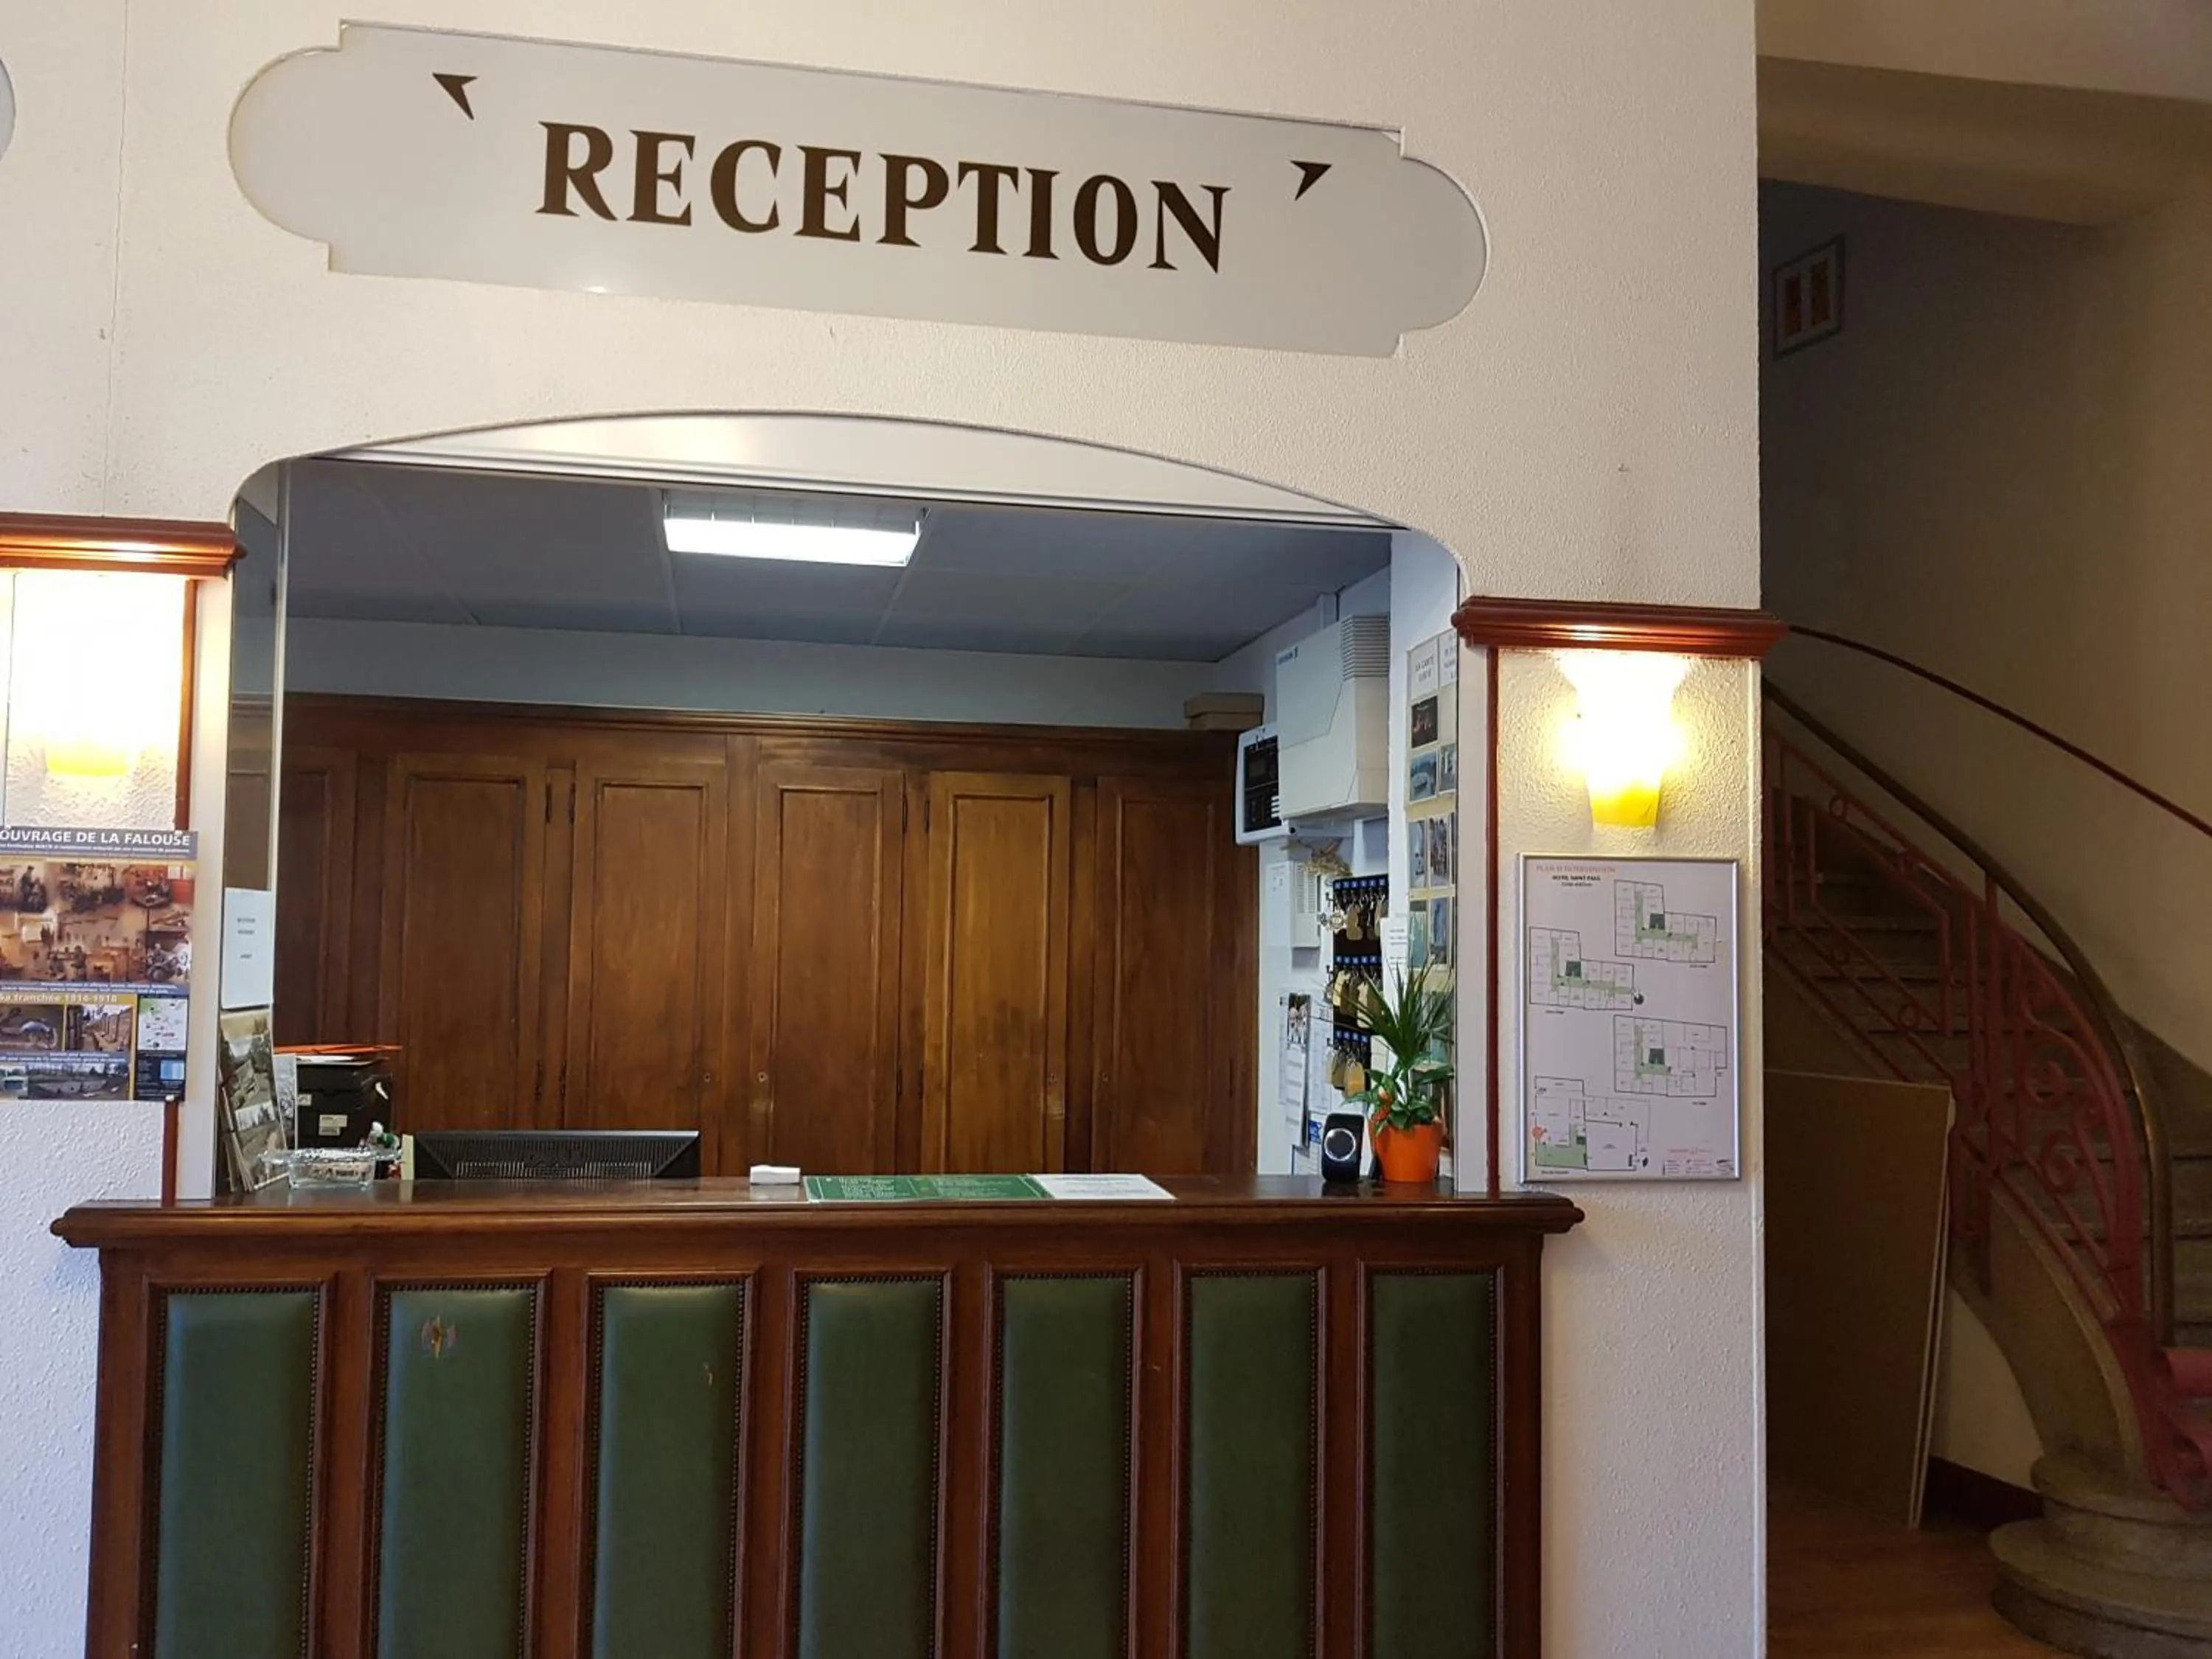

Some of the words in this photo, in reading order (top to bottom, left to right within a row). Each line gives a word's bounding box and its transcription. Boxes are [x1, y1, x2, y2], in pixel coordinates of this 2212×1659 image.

[535, 121, 1232, 275] RECEPTION
[0, 830, 72, 843] OUVRAGE
[76, 831, 97, 843] DE
[101, 832, 119, 844] LA
[125, 833, 190, 846] FALOUSE
